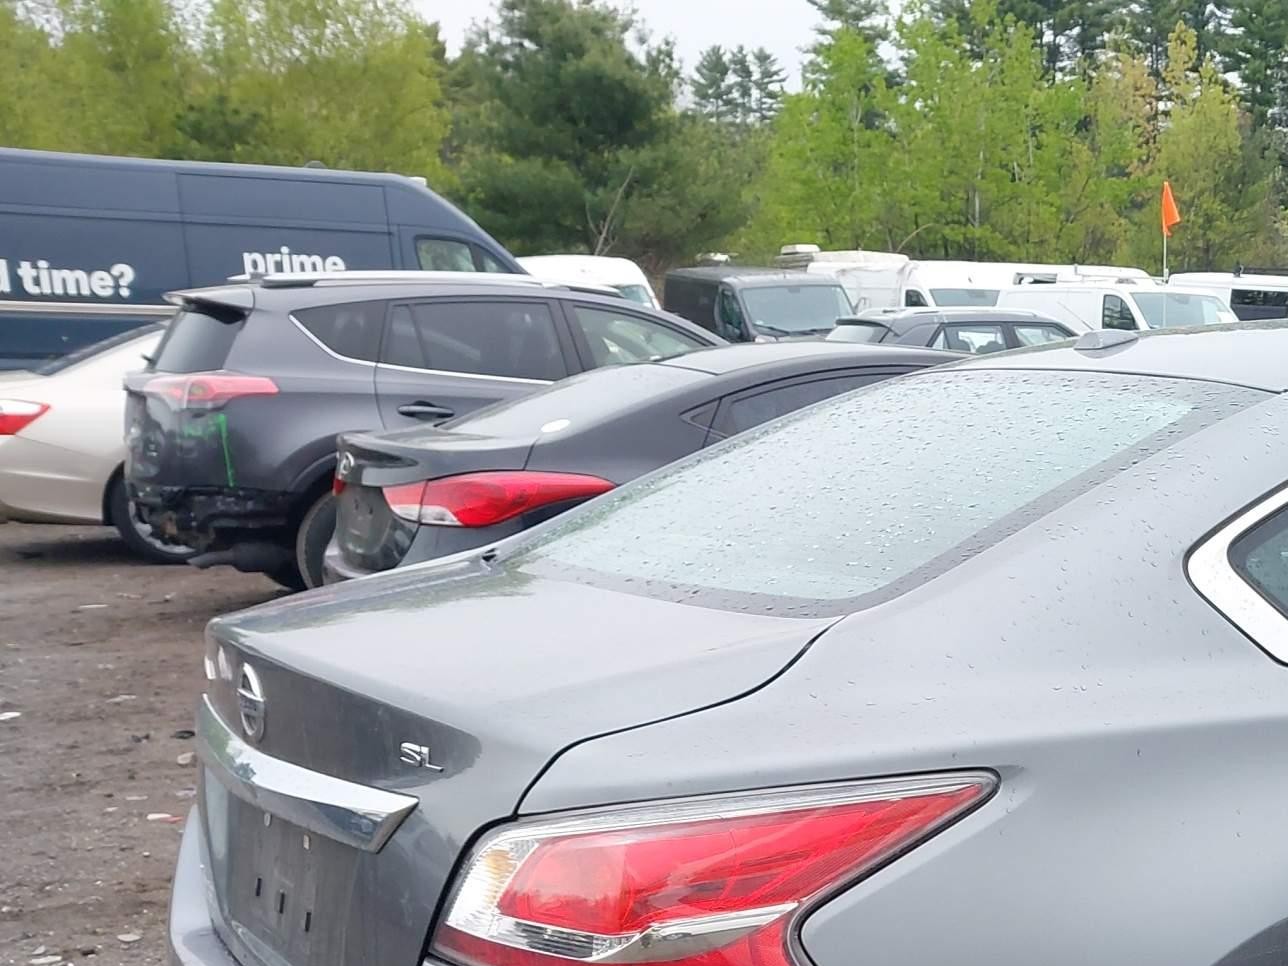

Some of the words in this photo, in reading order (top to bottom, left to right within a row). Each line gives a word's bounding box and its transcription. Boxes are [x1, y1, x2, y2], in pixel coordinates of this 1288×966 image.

[242, 246, 346, 273] prime
[17, 259, 135, 297] time?
[400, 742, 444, 770] SL
